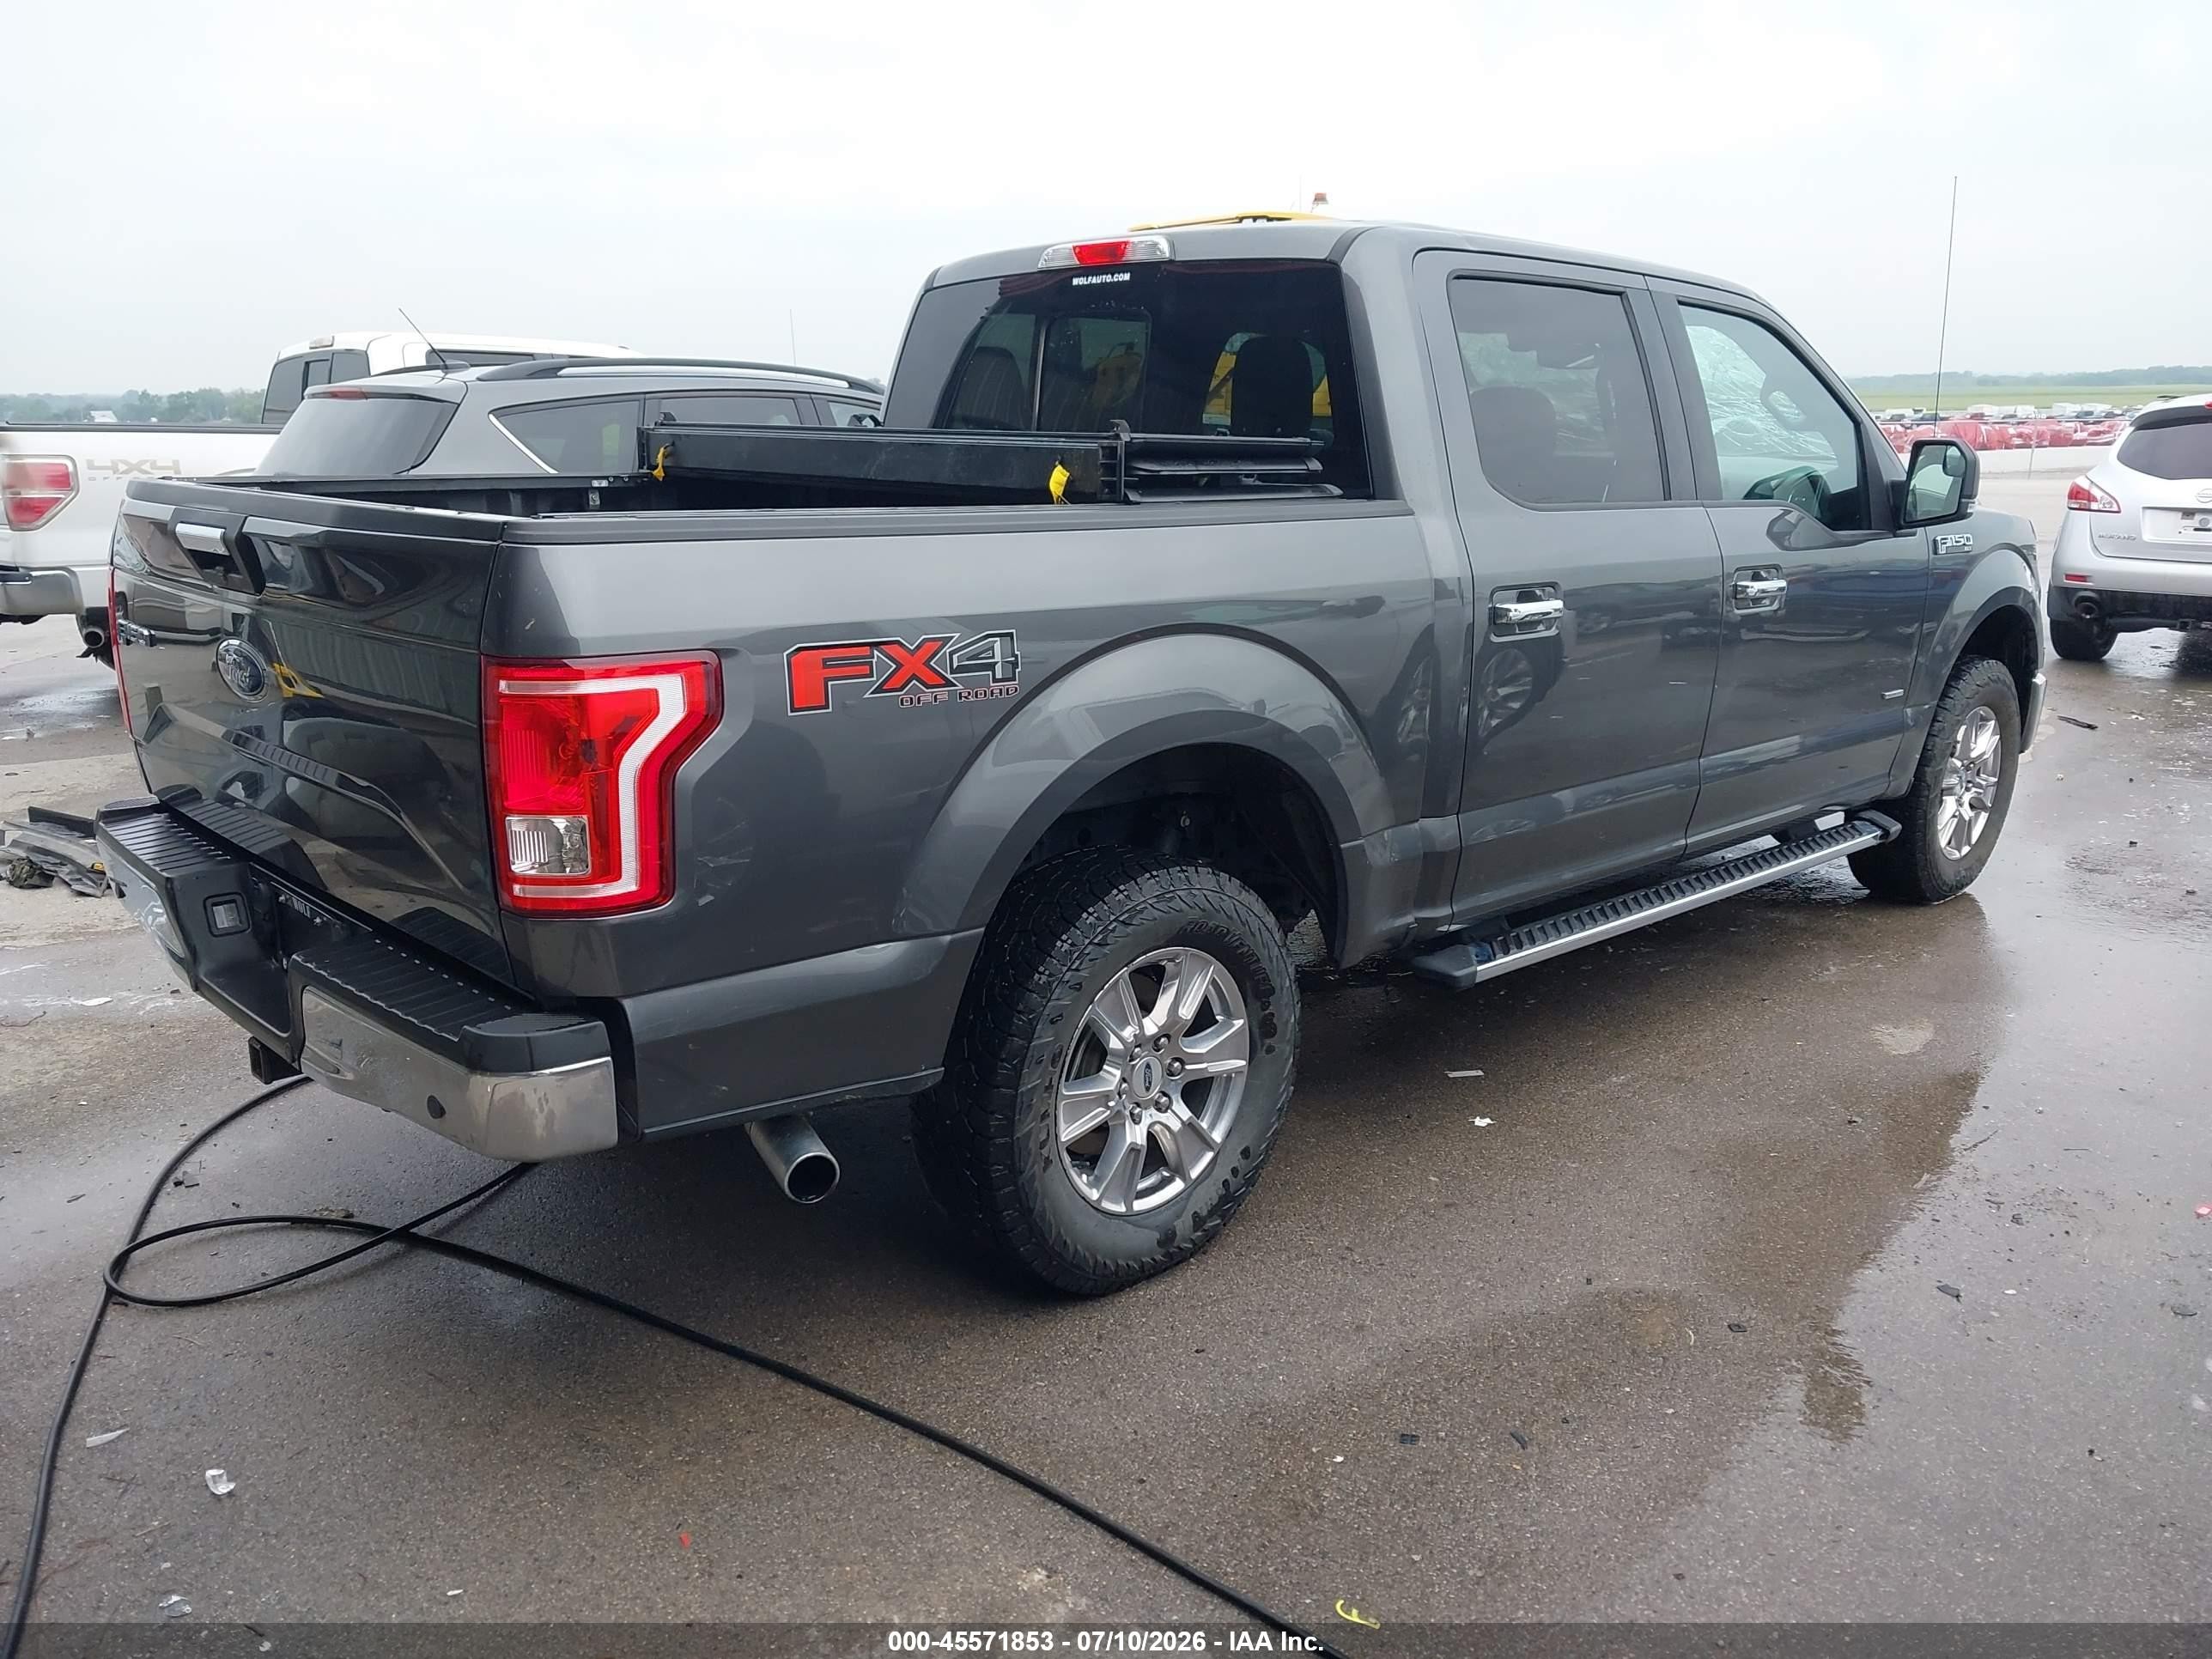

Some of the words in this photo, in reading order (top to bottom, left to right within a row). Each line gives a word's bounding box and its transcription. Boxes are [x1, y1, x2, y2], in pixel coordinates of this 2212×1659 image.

[1072, 271, 1131, 286] WOLFAUTO.COM
[783, 629, 1022, 716] FX4
[898, 692, 949, 708] OFF
[957, 685, 1020, 702] ROAD
